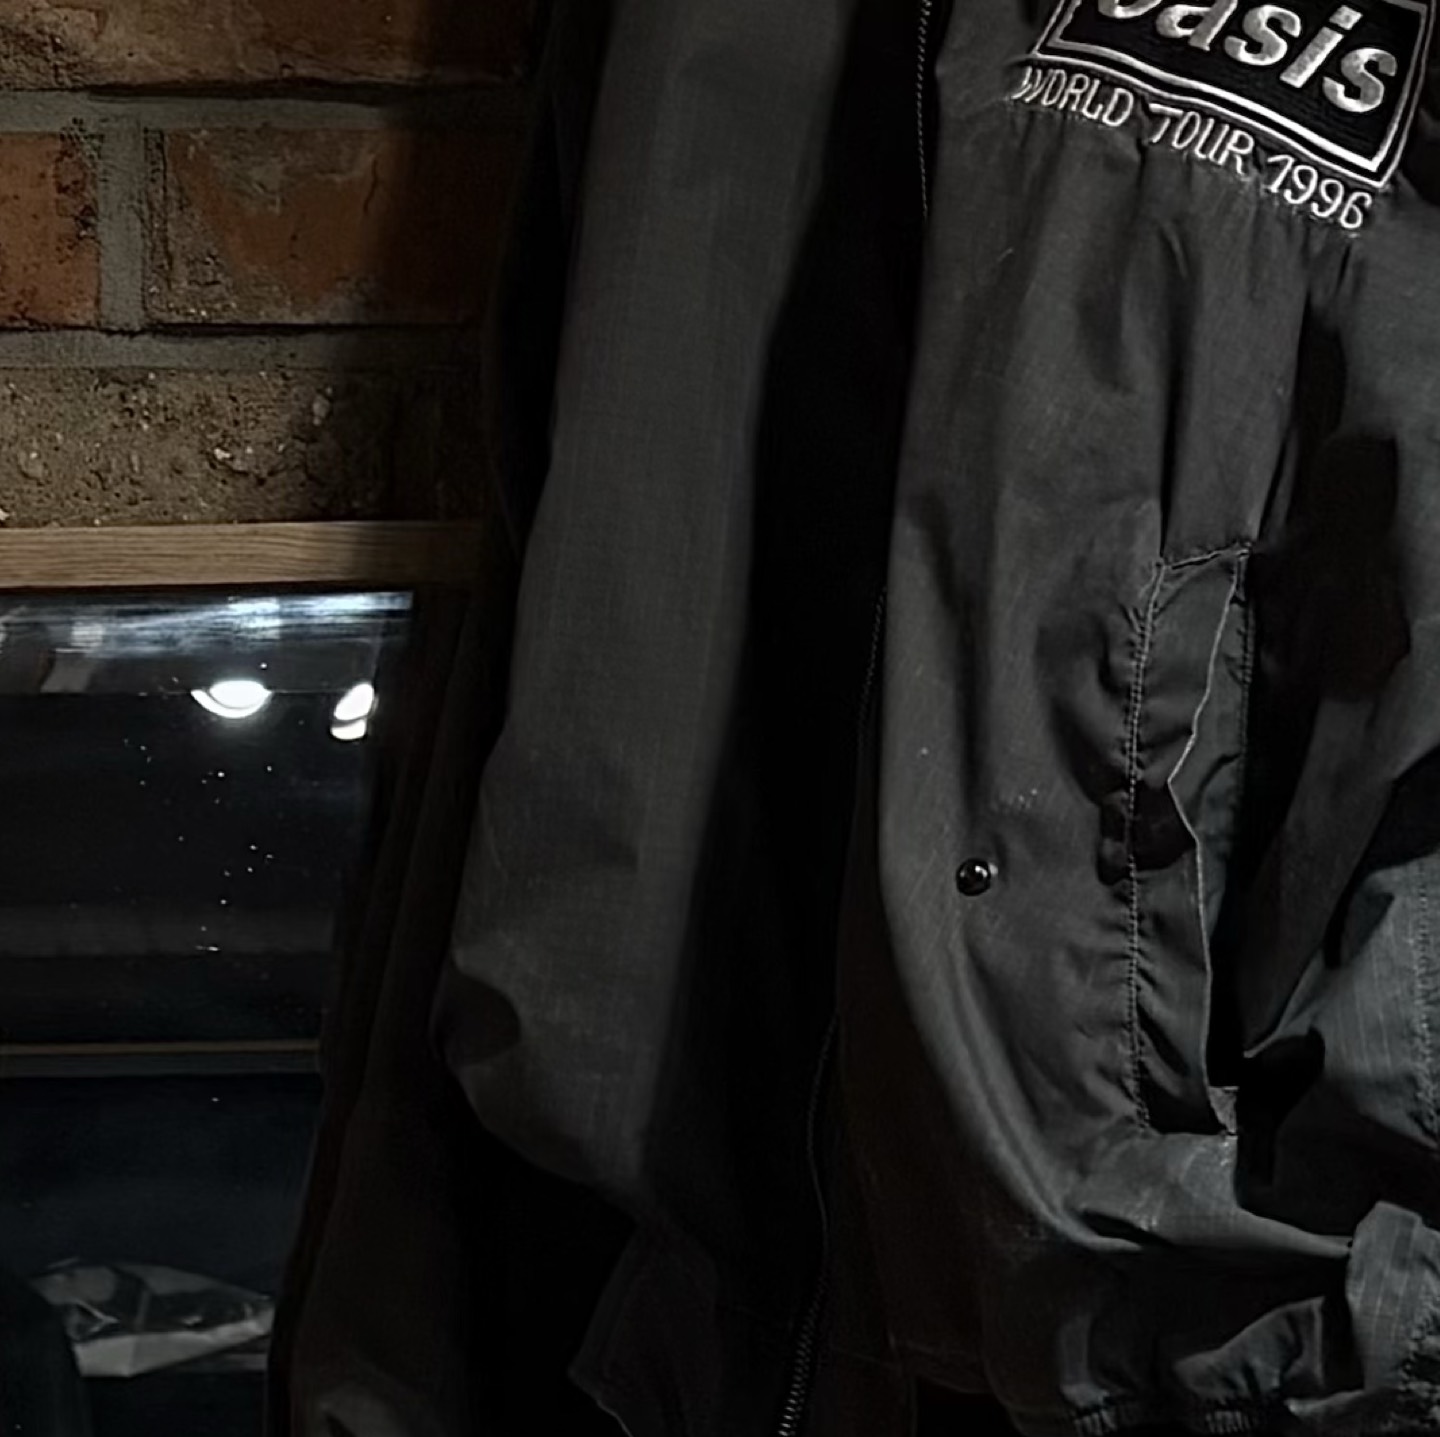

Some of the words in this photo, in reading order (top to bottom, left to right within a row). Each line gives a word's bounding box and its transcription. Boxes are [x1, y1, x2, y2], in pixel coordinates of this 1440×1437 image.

[1011, 66, 1135, 127] WORLD
[1148, 103, 1257, 176] TOUR
[1266, 153, 1373, 230] 1996
